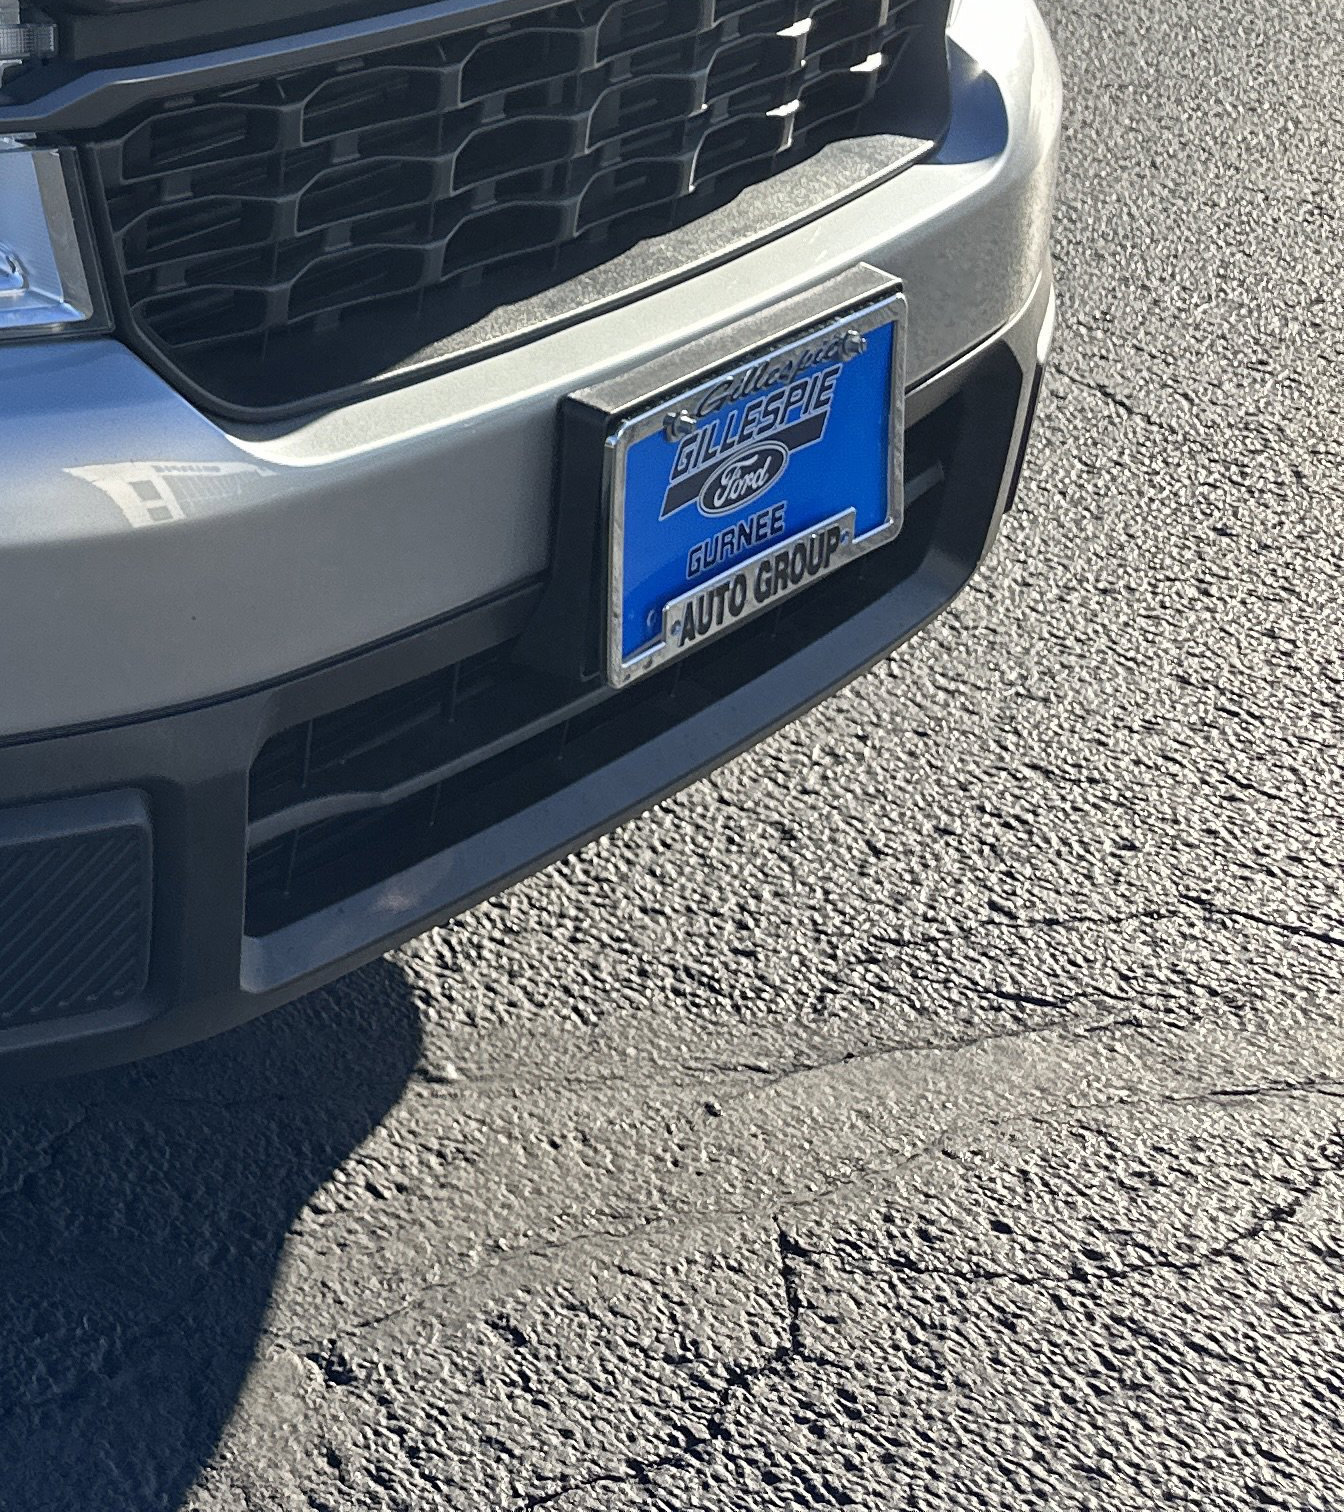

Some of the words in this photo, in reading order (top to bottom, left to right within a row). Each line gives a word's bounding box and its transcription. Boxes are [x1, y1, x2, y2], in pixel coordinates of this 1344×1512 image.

[668, 363, 843, 486] GILLESPIE
[713, 453, 772, 509] Ford
[678, 571, 748, 647] AUTO
[754, 524, 843, 604] GROUP
[685, 500, 787, 581] GURNEE
